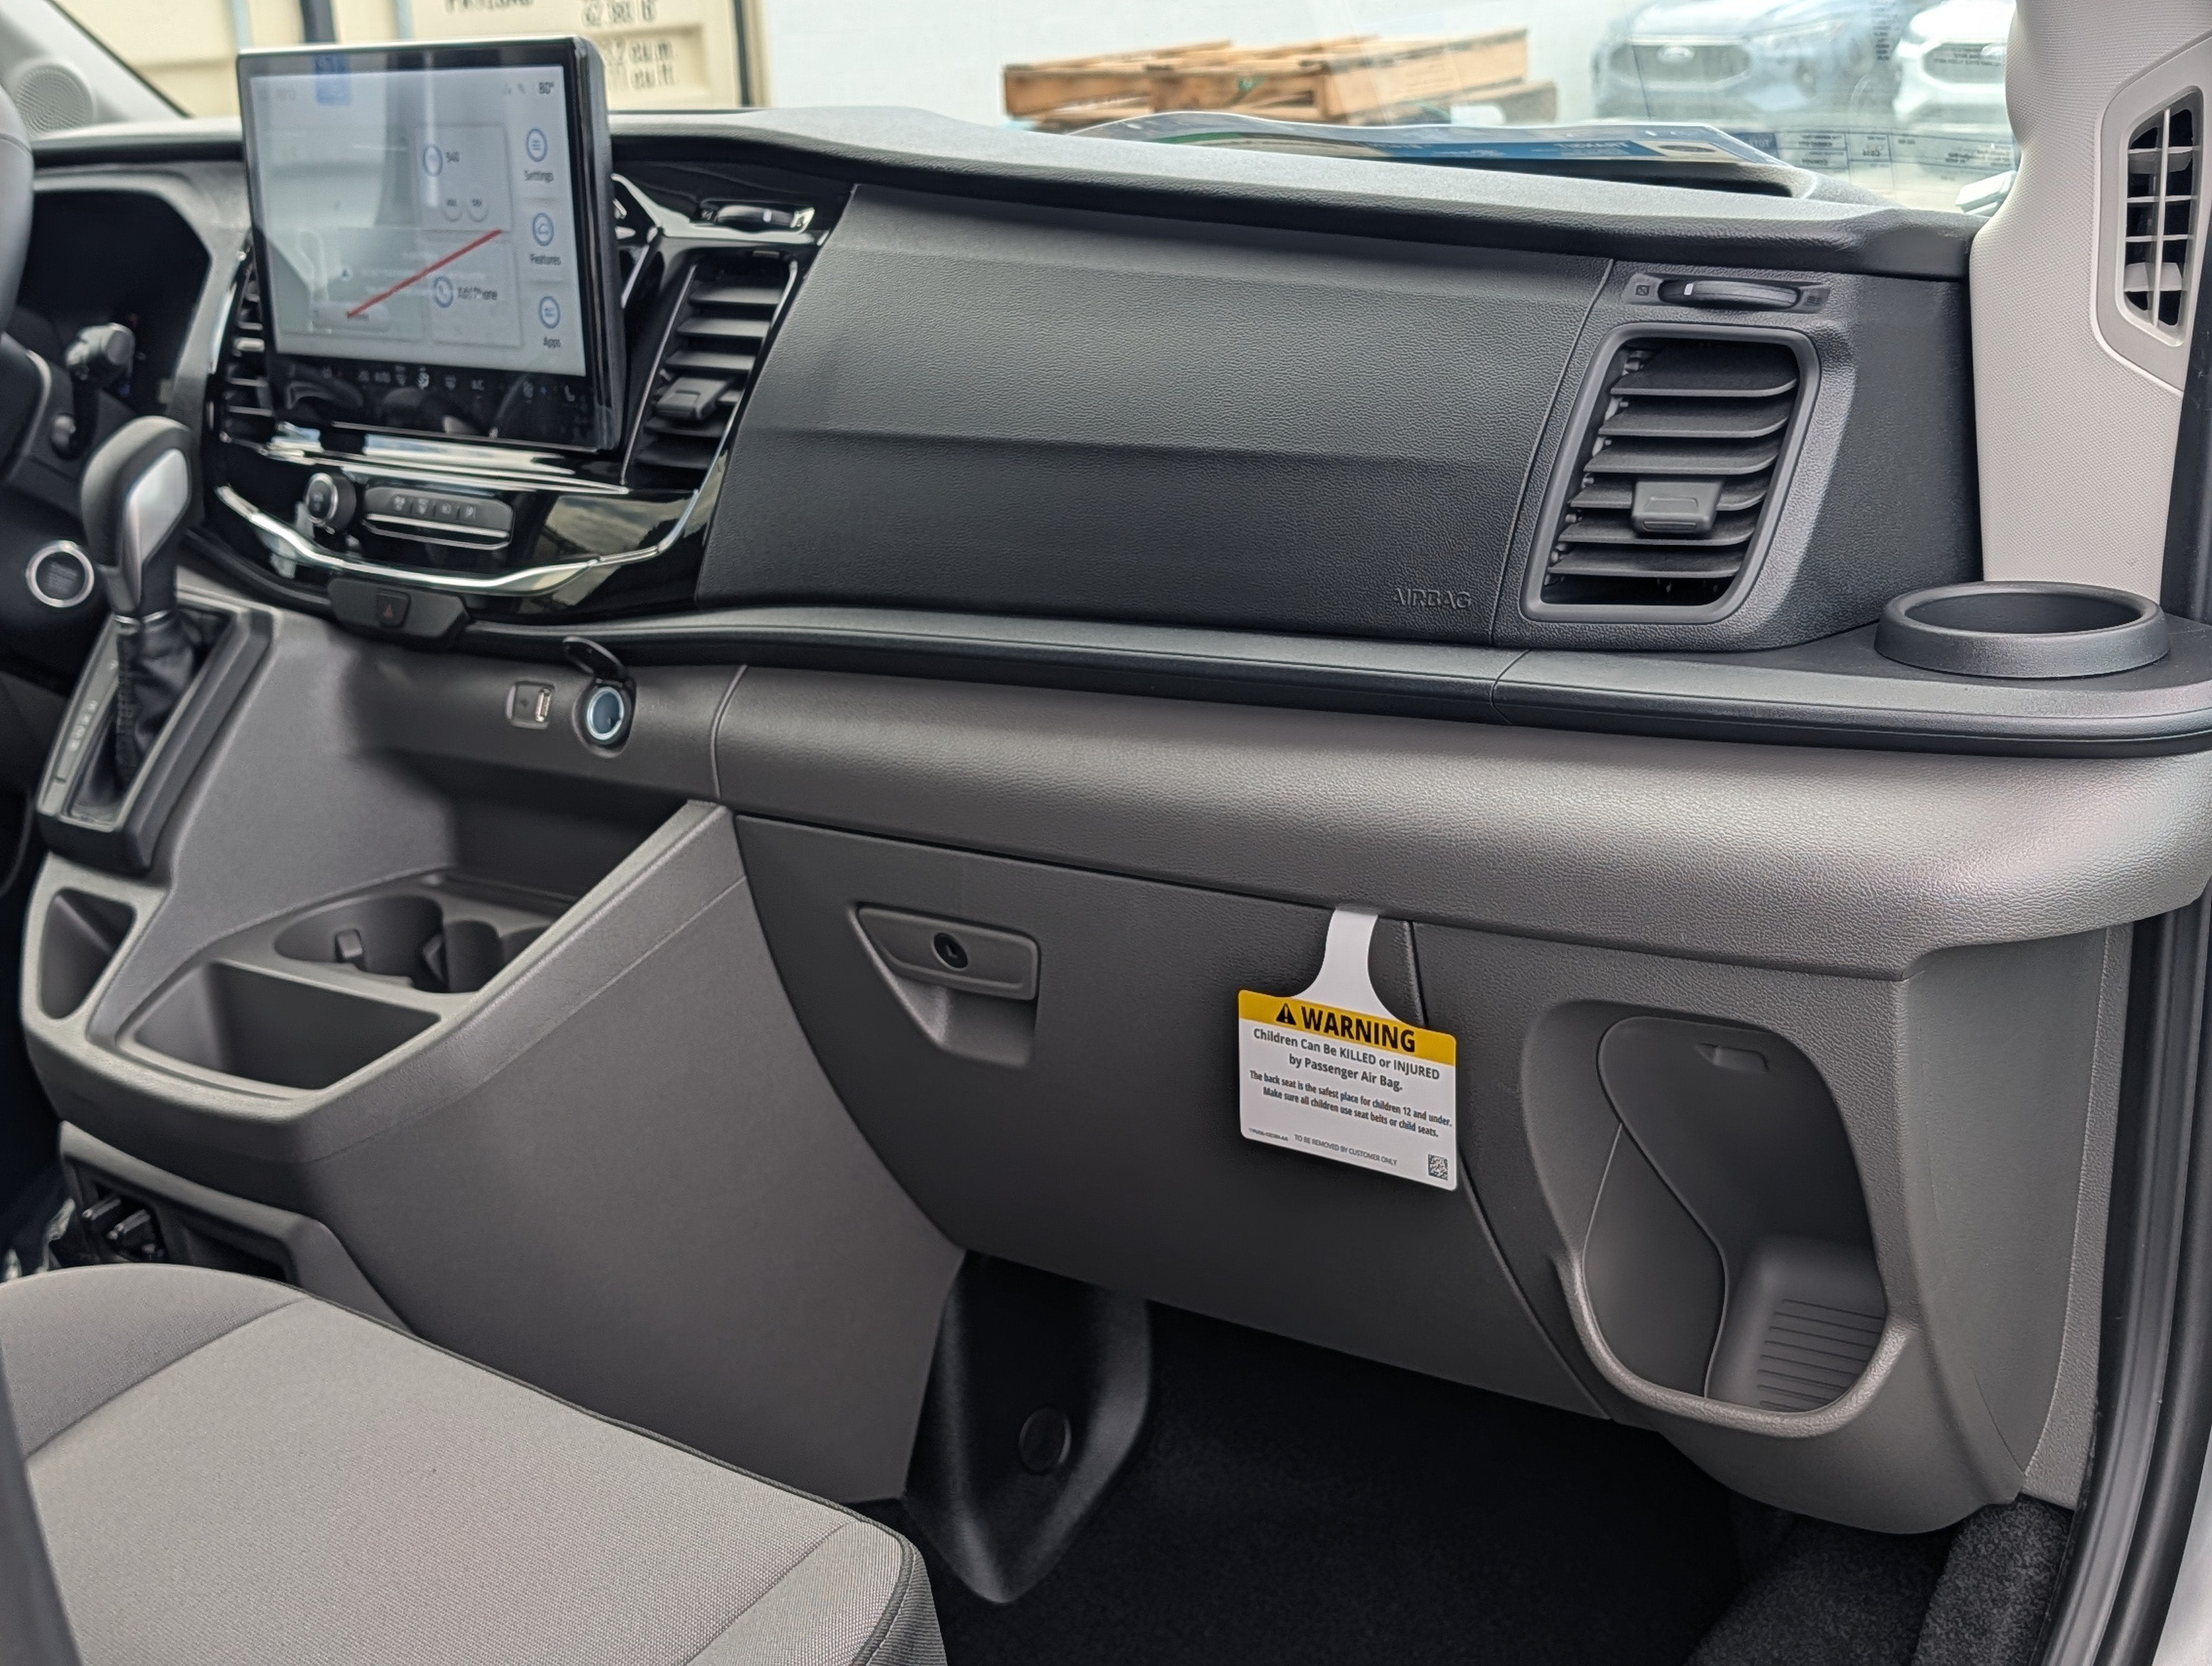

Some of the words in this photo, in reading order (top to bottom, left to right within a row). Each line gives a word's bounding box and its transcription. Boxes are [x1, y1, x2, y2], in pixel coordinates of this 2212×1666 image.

[524, 170, 554, 183] Settings
[530, 253, 561, 266] Features
[543, 336, 561, 348] Apps
[1394, 588, 1472, 611] AIRBAG
[1301, 1005, 1416, 1053] WARNING
[1253, 1028, 1298, 1048] Children
[1301, 1039, 1321, 1053] Can
[1323, 1043, 1337, 1056] Be
[1340, 1047, 1376, 1065] KILLED
[1379, 1059, 1391, 1069] or
[1393, 1060, 1440, 1080] INJURED
[1289, 1053, 1302, 1069] by
[1304, 1058, 1359, 1080] Passenger
[1360, 1071, 1377, 1084] Air
[1380, 1075, 1403, 1092] Bag.
[1250, 1070, 1263, 1081] The
[1264, 1073, 1280, 1085] back
[1281, 1078, 1296, 1088] seat
[1298, 1081, 1303, 1091] is
[1305, 1082, 1316, 1093] the
[1318, 1087, 1339, 1099] safest
[1340, 1091, 1359, 1104] place
[1360, 1095, 1371, 1106] for
[1372, 1099, 1401, 1114] children
[1403, 1106, 1411, 1117] 12
[1413, 1110, 1427, 1120] and
[1429, 1113, 1452, 1127] under.
[1263, 1086, 1282, 1099] Make
[1284, 1092, 1299, 1103] sure
[1301, 1095, 1309, 1105] all
[1310, 1098, 1339, 1112] children
[1340, 1106, 1353, 1116] use
[1354, 1110, 1369, 1120] seat
[1370, 1112, 1387, 1124] belts
[1398, 1119, 1416, 1131] child
[1418, 1125, 1439, 1137] seats.
[1294, 1134, 1303, 1142] TO
[1304, 1136, 1311, 1144] BE
[1312, 1138, 1340, 1151] REMOVED
[1349, 1148, 1380, 1161] CUSTOMER
[1381, 1156, 1398, 1166] ONLY
